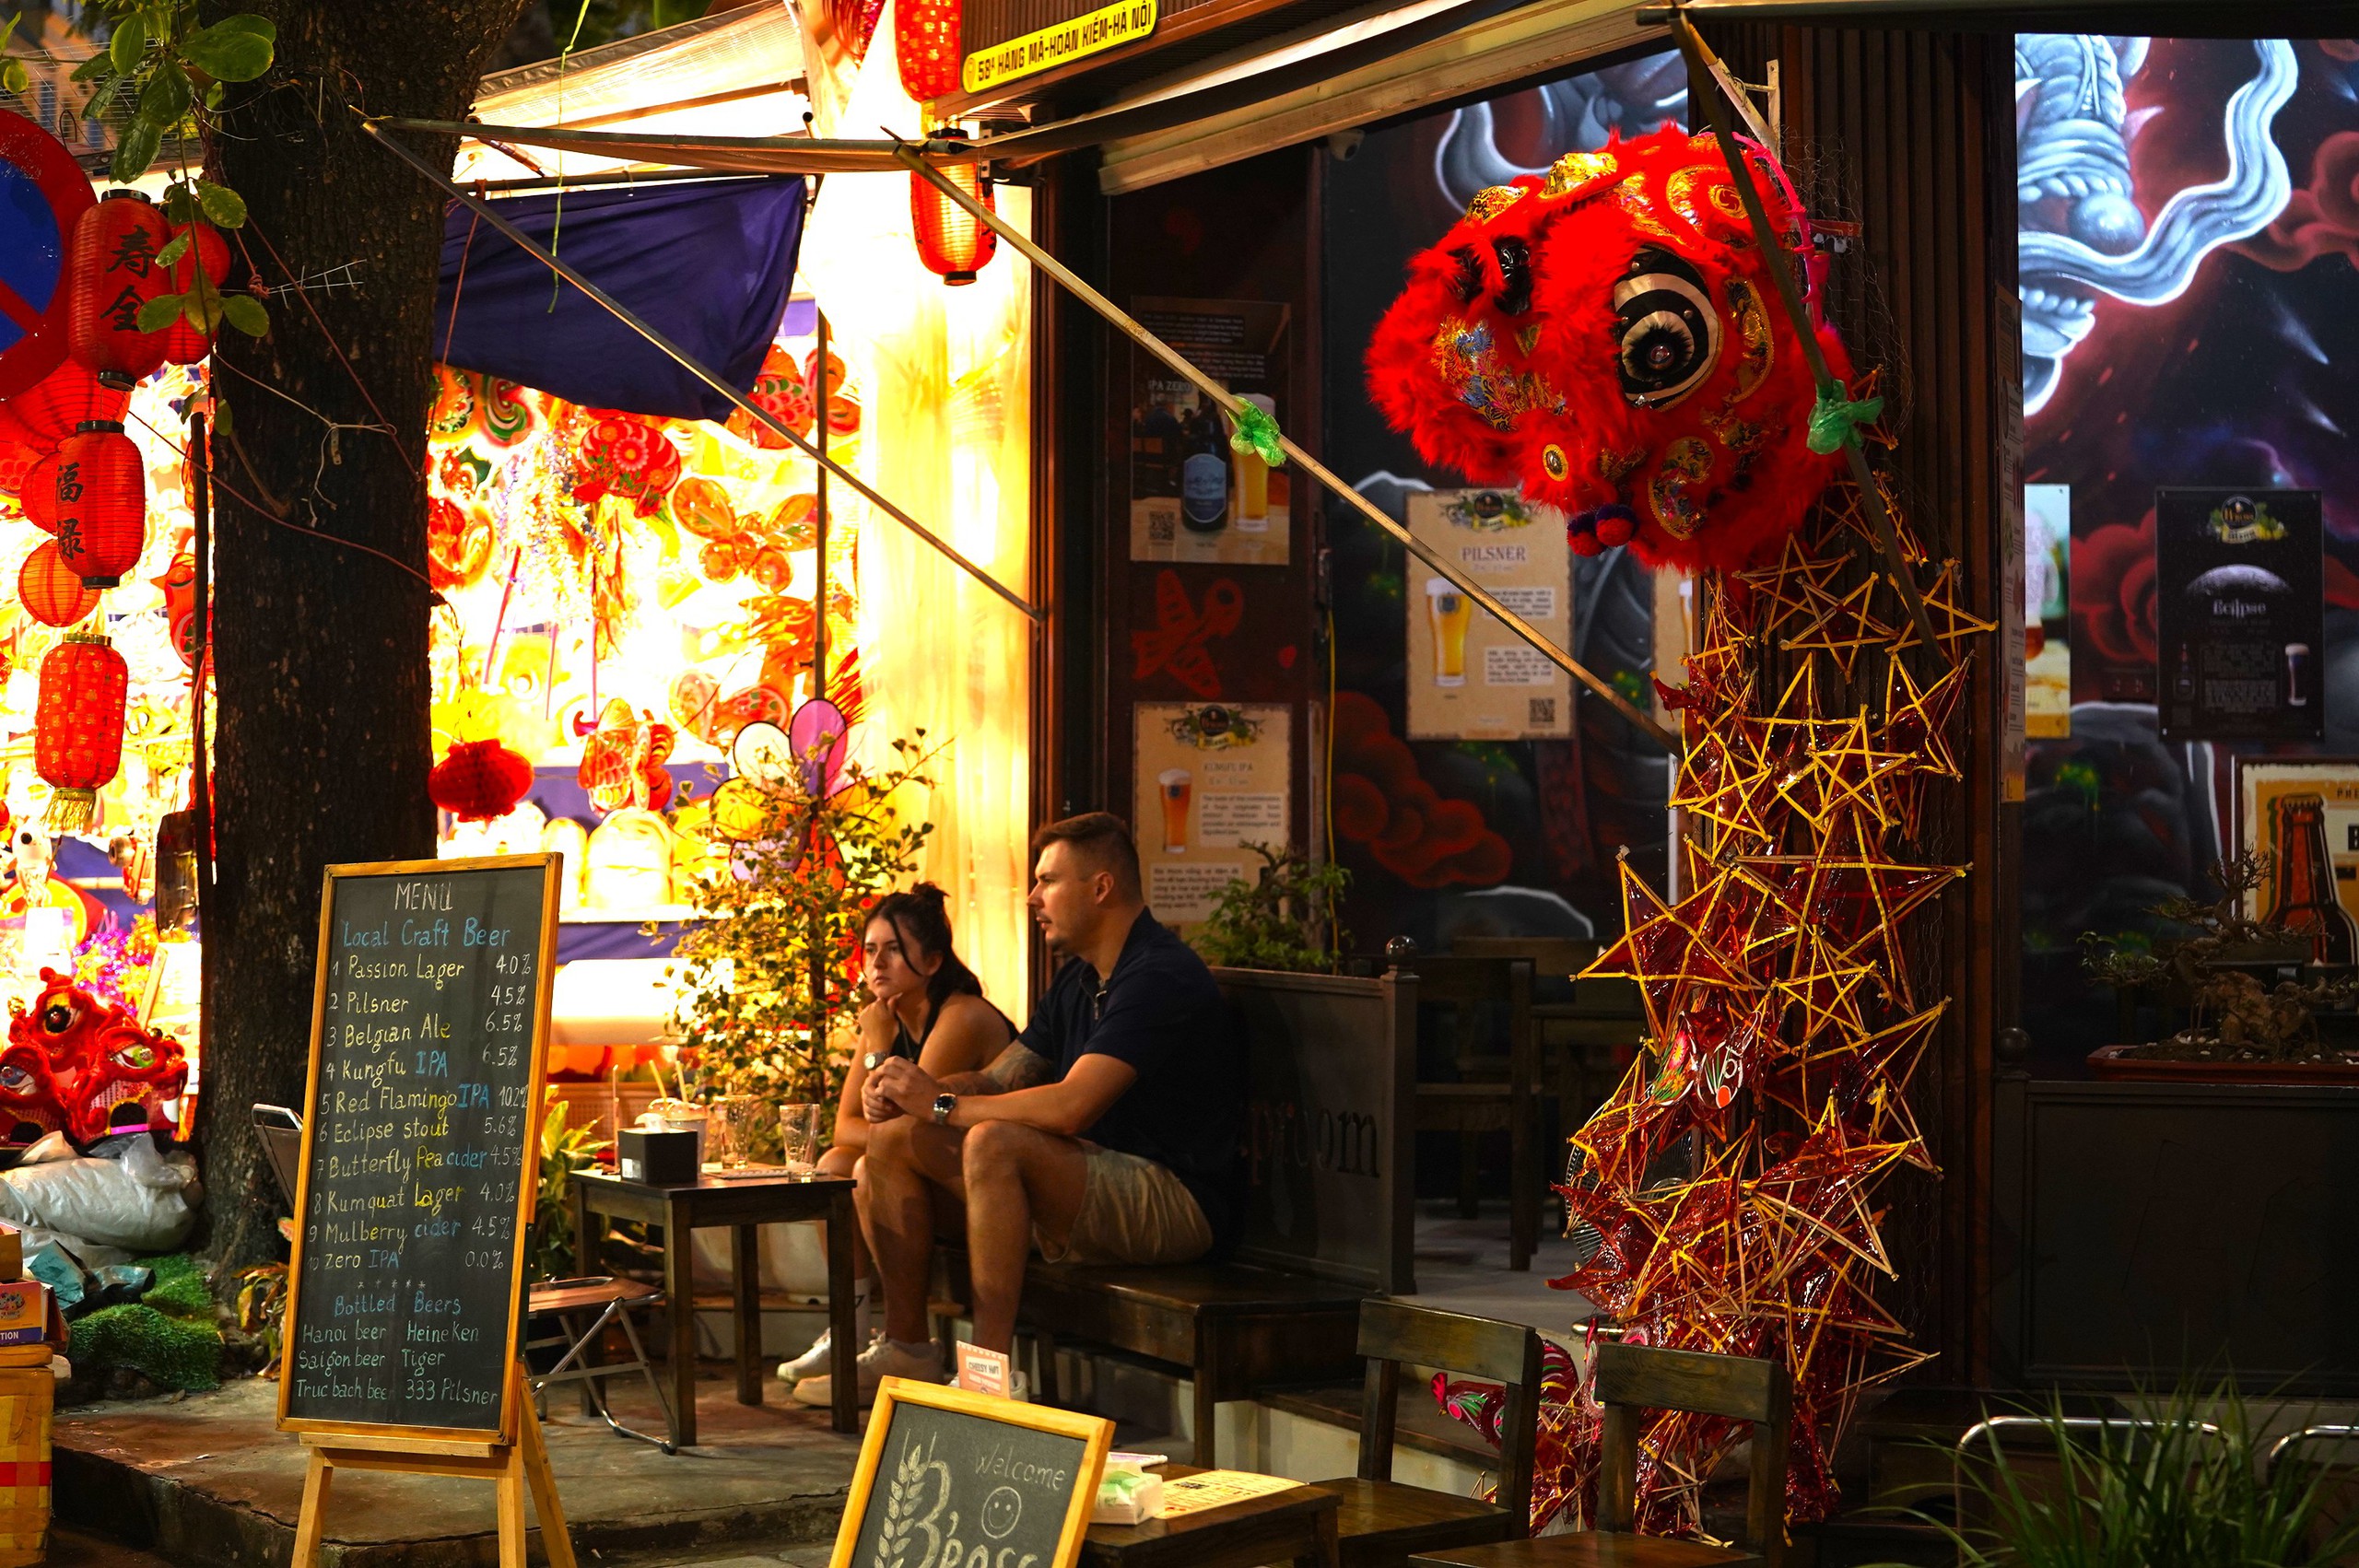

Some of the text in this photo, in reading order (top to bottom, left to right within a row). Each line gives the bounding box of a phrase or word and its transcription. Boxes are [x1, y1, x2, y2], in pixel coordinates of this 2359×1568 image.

[997, 46, 1026, 76] HÀNG
[1132, 0, 1151, 33] NỘI
[1461, 546, 1527, 562] PILSNER
[394, 882, 453, 911] MENU
[343, 917, 511, 948] Local Craft Beer
[333, 954, 532, 990] 1 Passion Lager 4.0%
[329, 985, 525, 1013] 2 Pilsner 4.5%
[327, 1011, 523, 1053] 3 Belgian Ale 6.5%
[325, 1044, 518, 1088] 4 Kungfu IPA 6.5%
[320, 1094, 330, 1115] 5
[335, 1091, 370, 1113] Red
[380, 1086, 457, 1119] Flamingo
[457, 1083, 489, 1109] IPA
[319, 1115, 517, 1151] 6 Eclipse stout 5.6%
[317, 1158, 324, 1179] 7
[329, 1148, 412, 1184] Butterfly
[417, 1145, 443, 1169] Pea
[490, 1144, 523, 1167] 4.5%
[314, 1178, 515, 1219] 8 Kumquat Lager 4.0%
[309, 1215, 511, 1255] 9 Mulberry cider 4.5%
[369, 1249, 400, 1269] IPA
[464, 1250, 504, 1270] 0.0%
[334, 1290, 461, 1317] Bottled Beers
[302, 1318, 387, 1344] Hanoi beer
[299, 1346, 386, 1377] Saigon beer
[401, 1348, 446, 1376] Tiger
[296, 1379, 328, 1398] Truc
[333, 1375, 362, 1398] bach
[405, 1377, 499, 1405] 333 Pilsner
[974, 1443, 1065, 1492] Welcome
